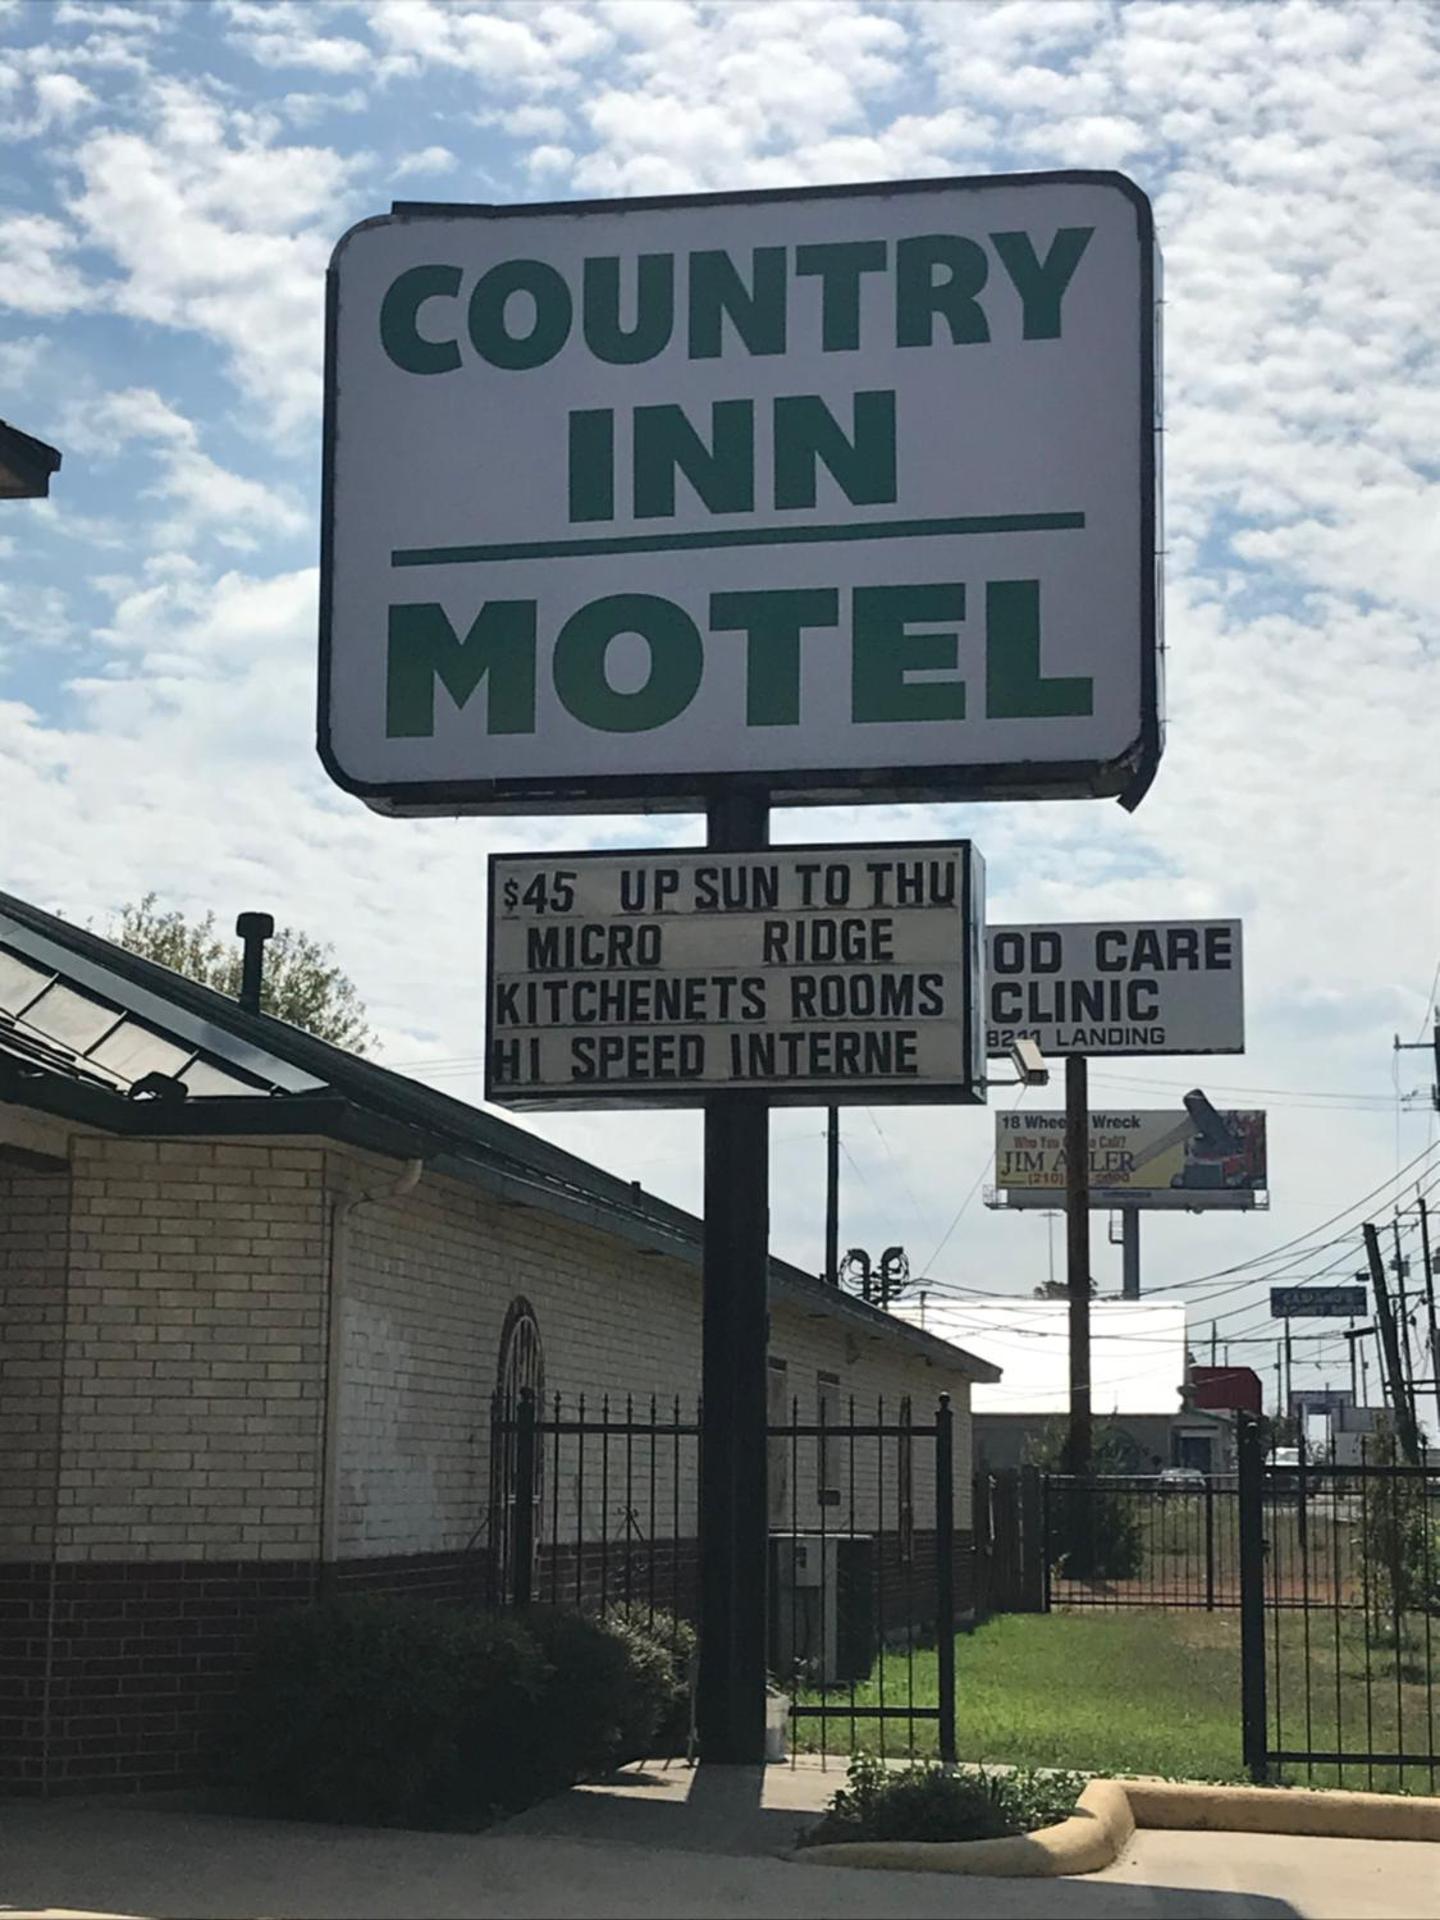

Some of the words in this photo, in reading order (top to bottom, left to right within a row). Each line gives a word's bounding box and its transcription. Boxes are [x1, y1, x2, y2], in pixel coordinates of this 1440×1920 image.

[379, 227, 1096, 375] COUNTRY
[567, 390, 897, 522] INN
[385, 579, 1094, 738] MOTEL
[503, 872, 577, 914] $45
[620, 868, 679, 911] UP
[695, 866, 778, 910] SUN
[795, 864, 850, 907] TO
[867, 861, 955, 907] THU
[528, 924, 662, 969] MICRO
[763, 919, 894, 963] RIDGE
[1096, 929, 1231, 972] CARE
[497, 977, 765, 1025] KITCHENETS
[791, 974, 944, 1019] ROOMS
[992, 980, 1157, 1023] CLINIC
[494, 1037, 541, 1081] HI
[571, 1034, 705, 1079] SPEED
[730, 1031, 918, 1077] INTERNE
[1056, 1028, 1164, 1048] LANDING
[1003, 1116, 1021, 1129] 18
[1092, 1115, 1141, 1129] Wreck
[1001, 1152, 1044, 1175] JIM
[1053, 1150, 1137, 1172] ALER
